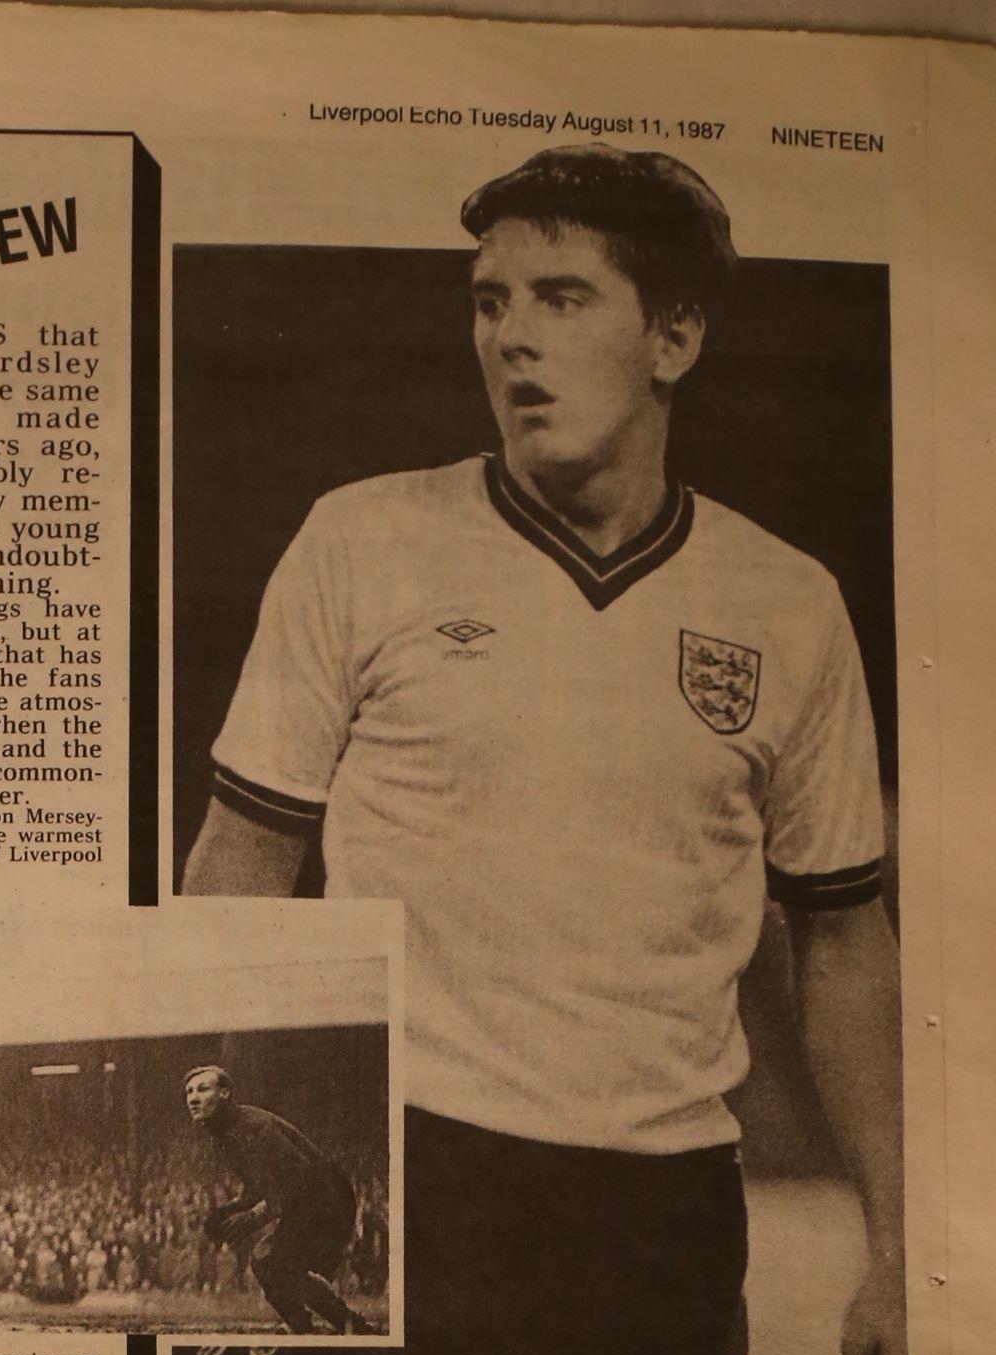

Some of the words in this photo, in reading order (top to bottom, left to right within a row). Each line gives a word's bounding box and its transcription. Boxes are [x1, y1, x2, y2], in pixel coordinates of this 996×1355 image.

[308, 102, 404, 127] Liverpool
[409, 105, 463, 127] Echo
[468, 107, 557, 133] Tuesday
[561, 110, 634, 137] August
[638, 115, 671, 139] 11,
[675, 117, 726, 141] 1987
[771, 126, 884, 153] NINETEEN
[38, 323, 99, 347] that
[26, 384, 100, 402] same
[16, 406, 100, 430] made
[40, 438, 100, 461] ago,
[44, 597, 101, 619] have
[9, 846, 102, 866] Liverpool
